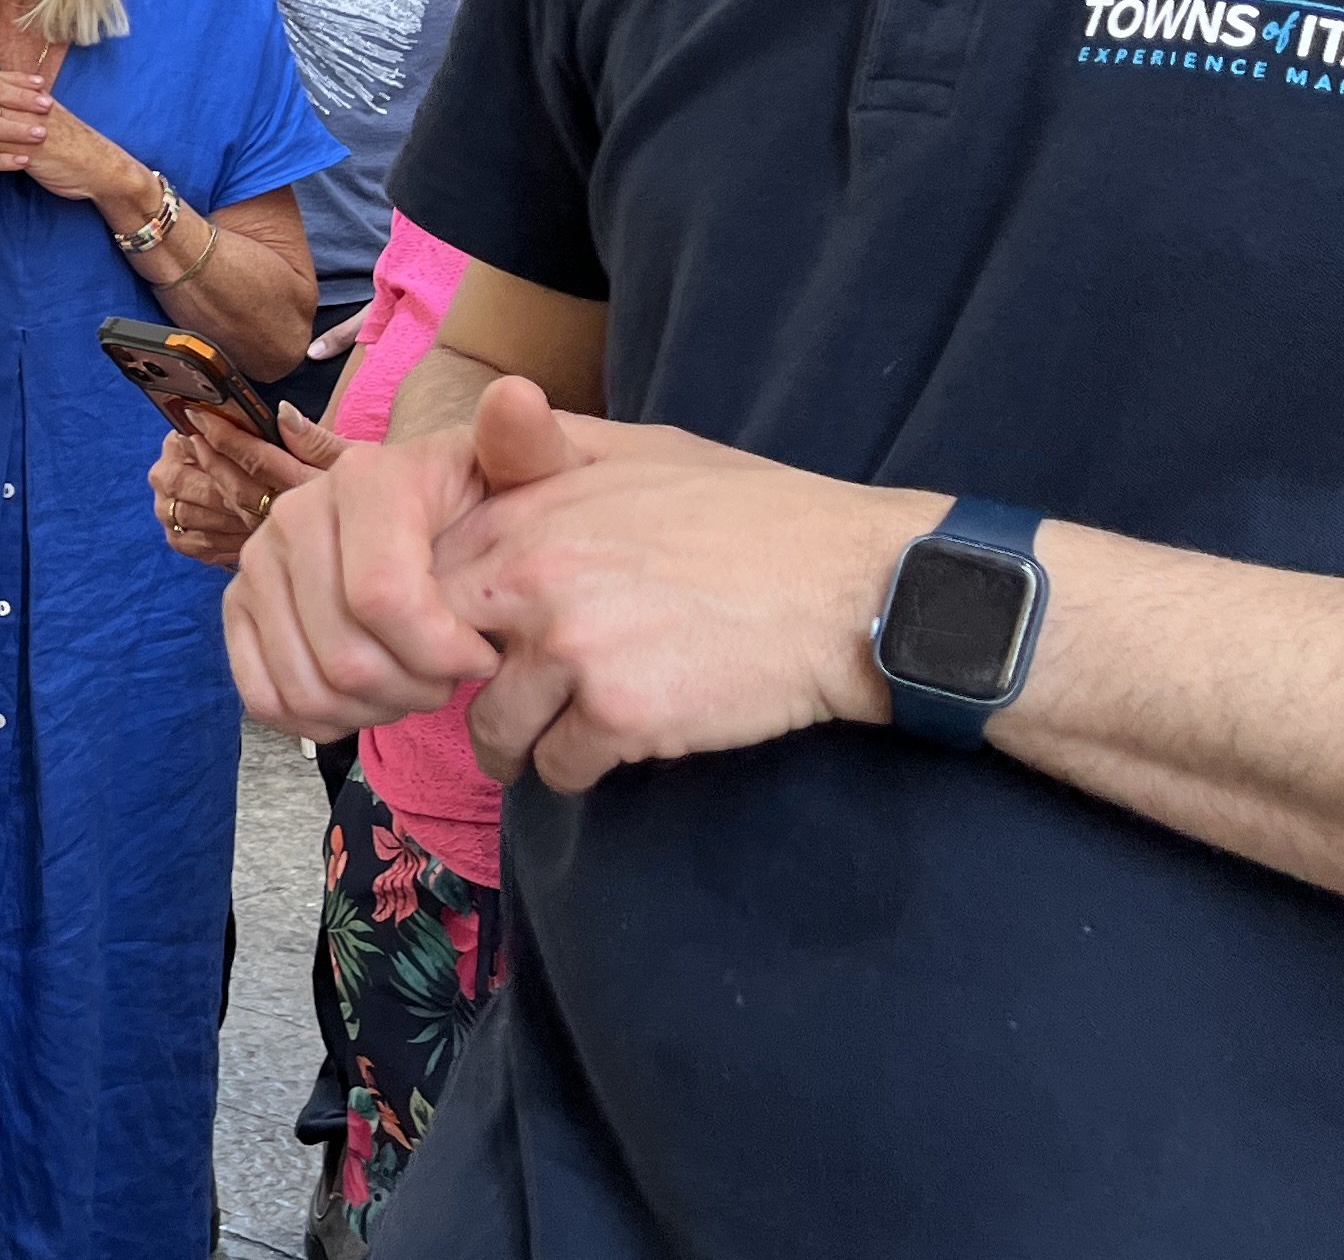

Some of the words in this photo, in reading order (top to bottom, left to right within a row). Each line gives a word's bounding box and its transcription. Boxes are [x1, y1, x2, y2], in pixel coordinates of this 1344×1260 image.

[1262, 10, 1301, 55] of
[1296, 13, 1344, 68] IT
[1077, 45, 1268, 80] EXPERIENCE
